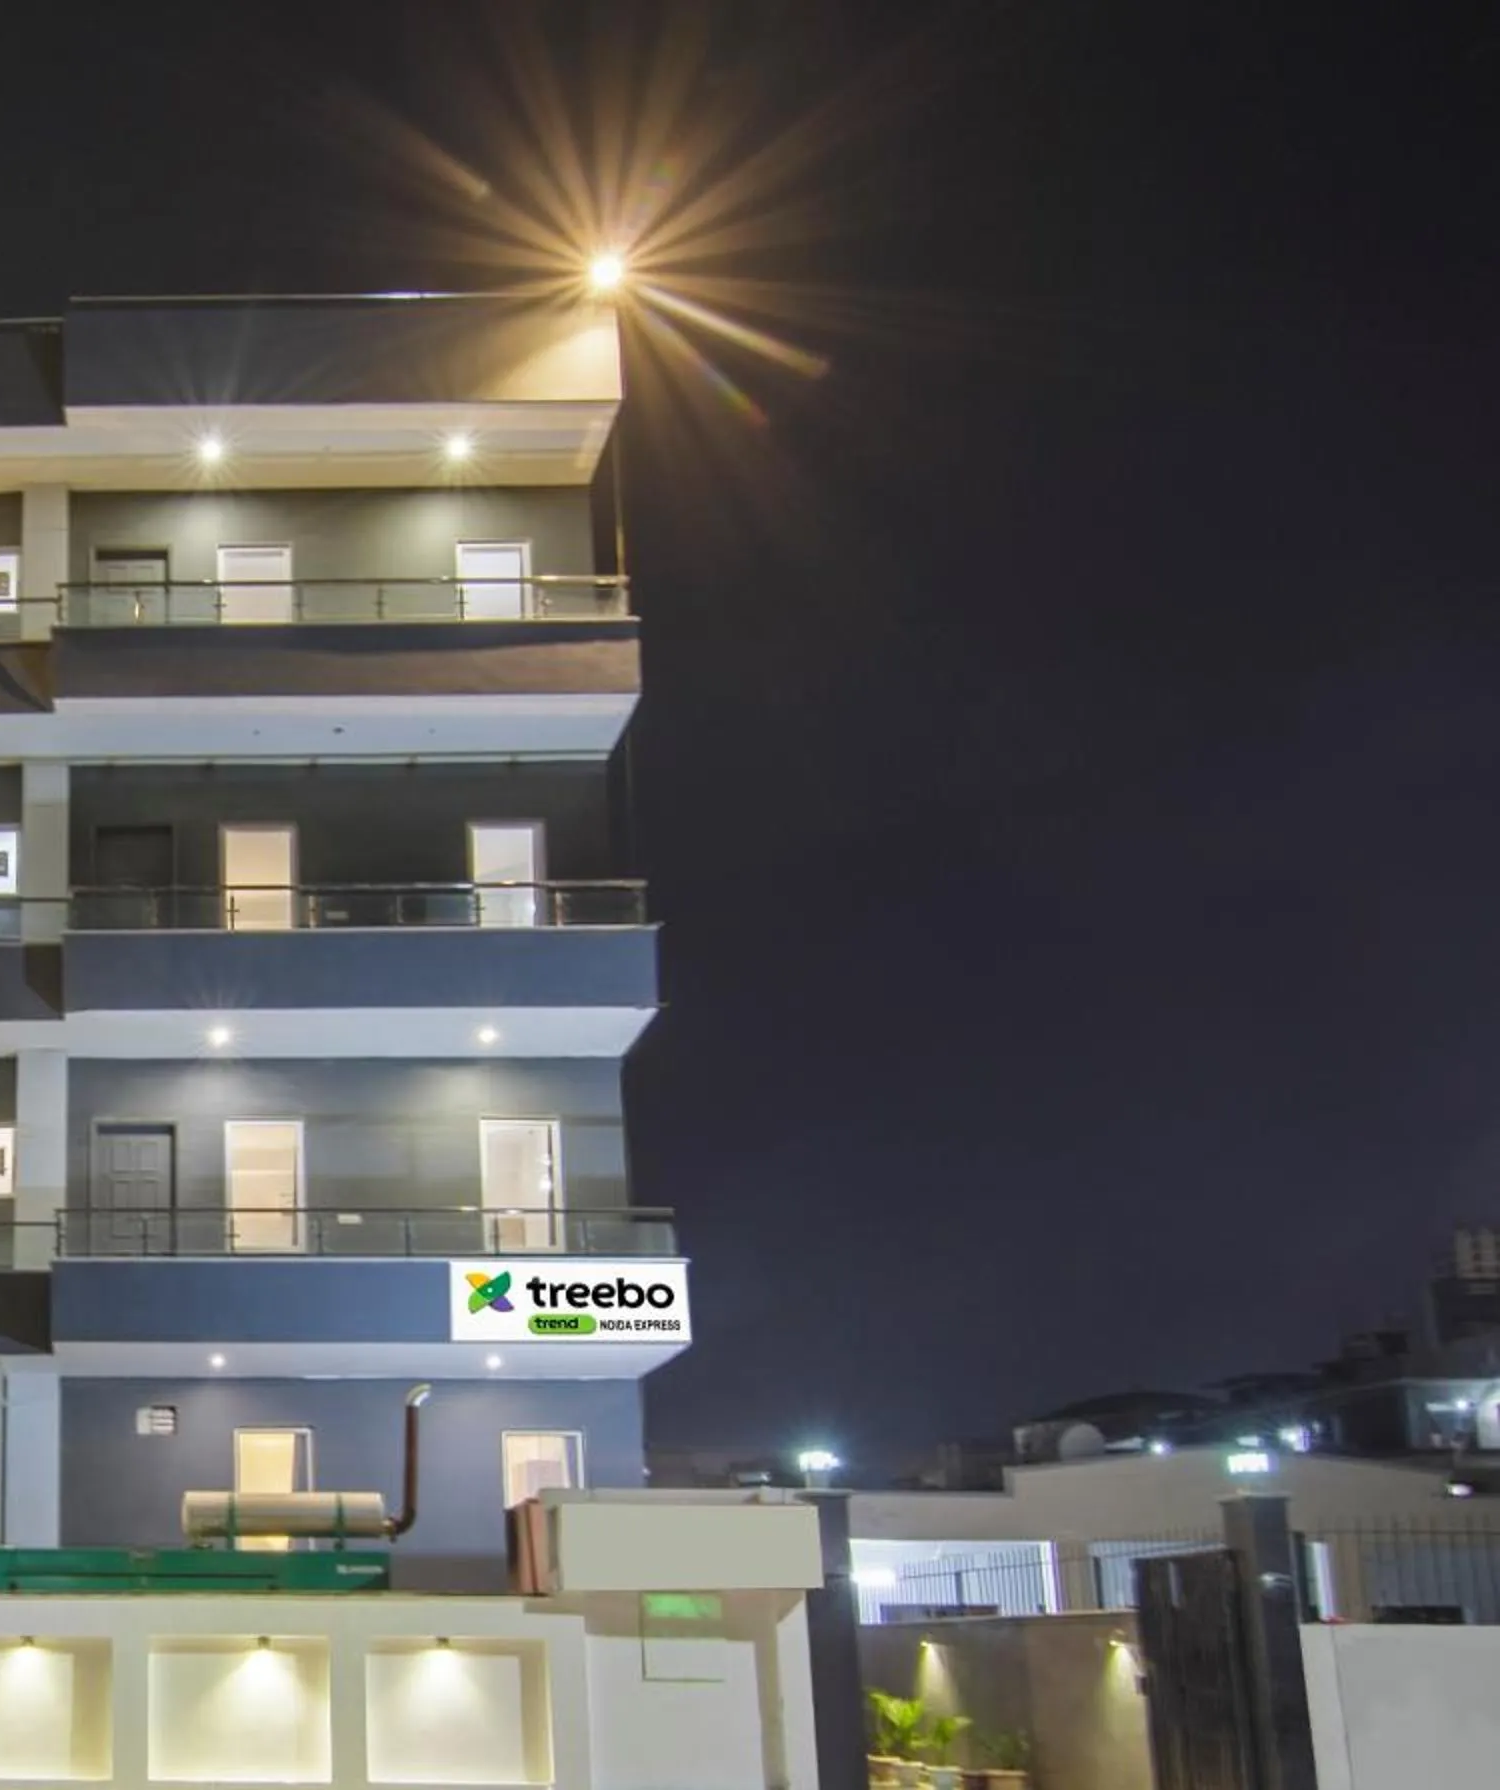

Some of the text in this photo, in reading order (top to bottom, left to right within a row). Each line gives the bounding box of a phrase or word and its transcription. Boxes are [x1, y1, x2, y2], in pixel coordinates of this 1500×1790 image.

[526, 1277, 675, 1309] treebo
[534, 1317, 681, 1331] trend NOIDA EXPRESS
